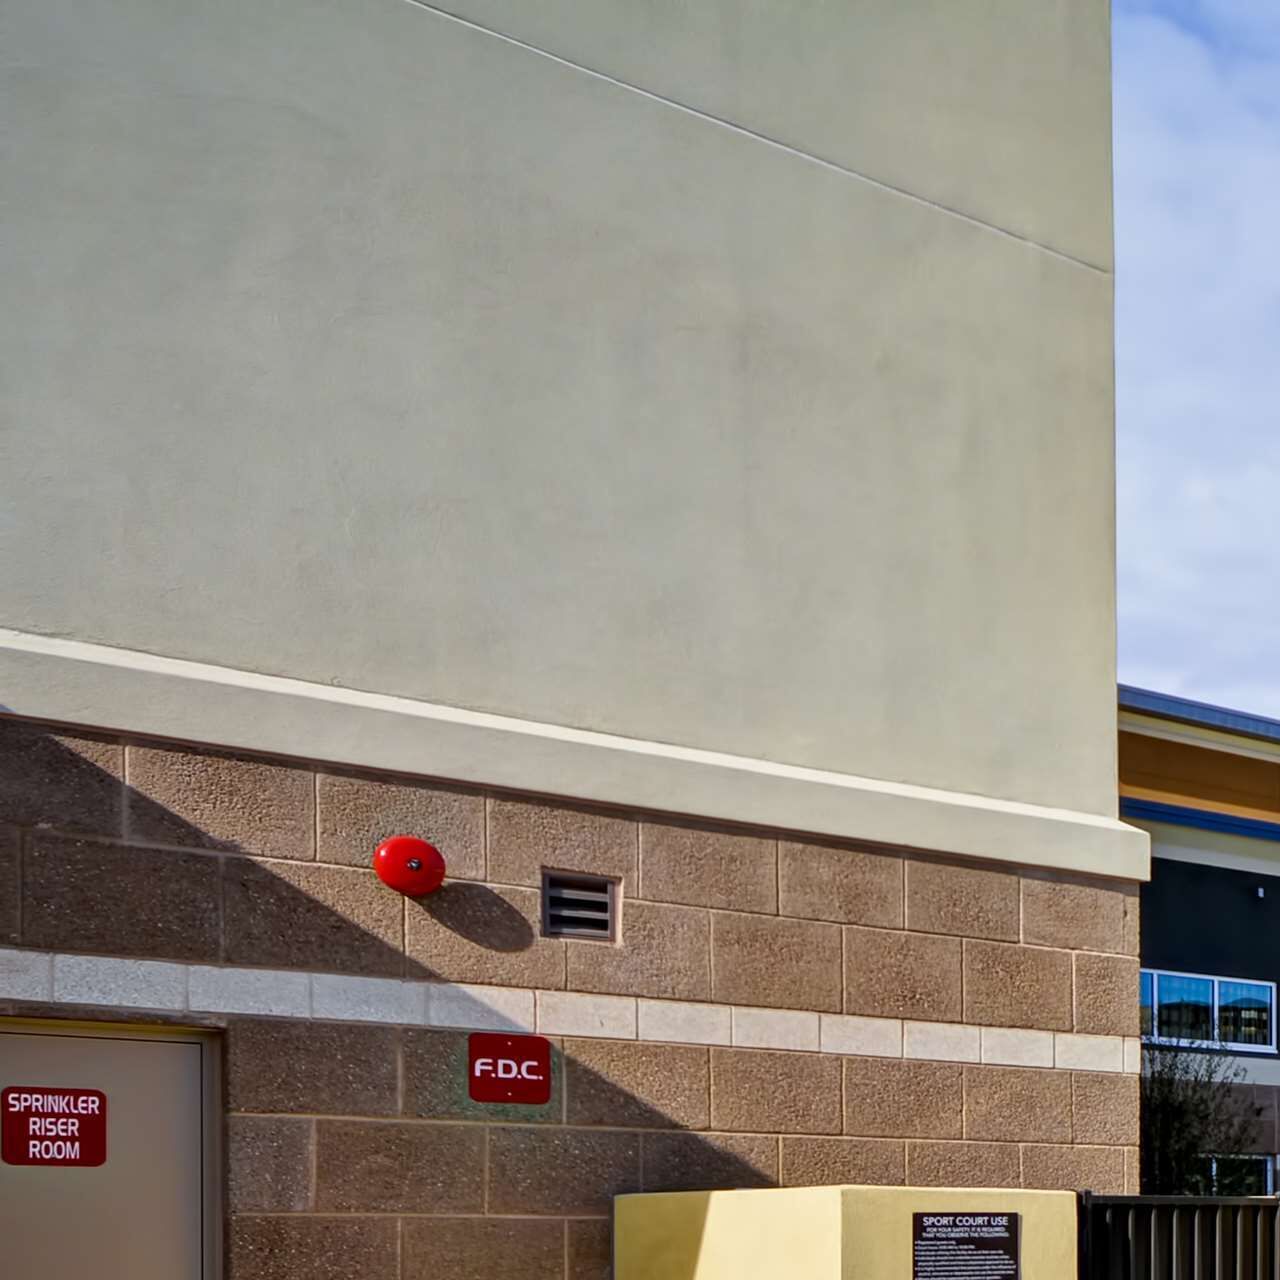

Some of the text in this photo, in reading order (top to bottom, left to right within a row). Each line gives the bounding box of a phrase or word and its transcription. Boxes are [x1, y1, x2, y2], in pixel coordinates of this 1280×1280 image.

[474, 1058, 544, 1080] F.D.C.
[8, 1093, 100, 1115] SPRINKLER
[28, 1117, 80, 1137] RISER
[28, 1140, 80, 1160] ROOM
[922, 1217, 1009, 1226] SPORT COURT USE
